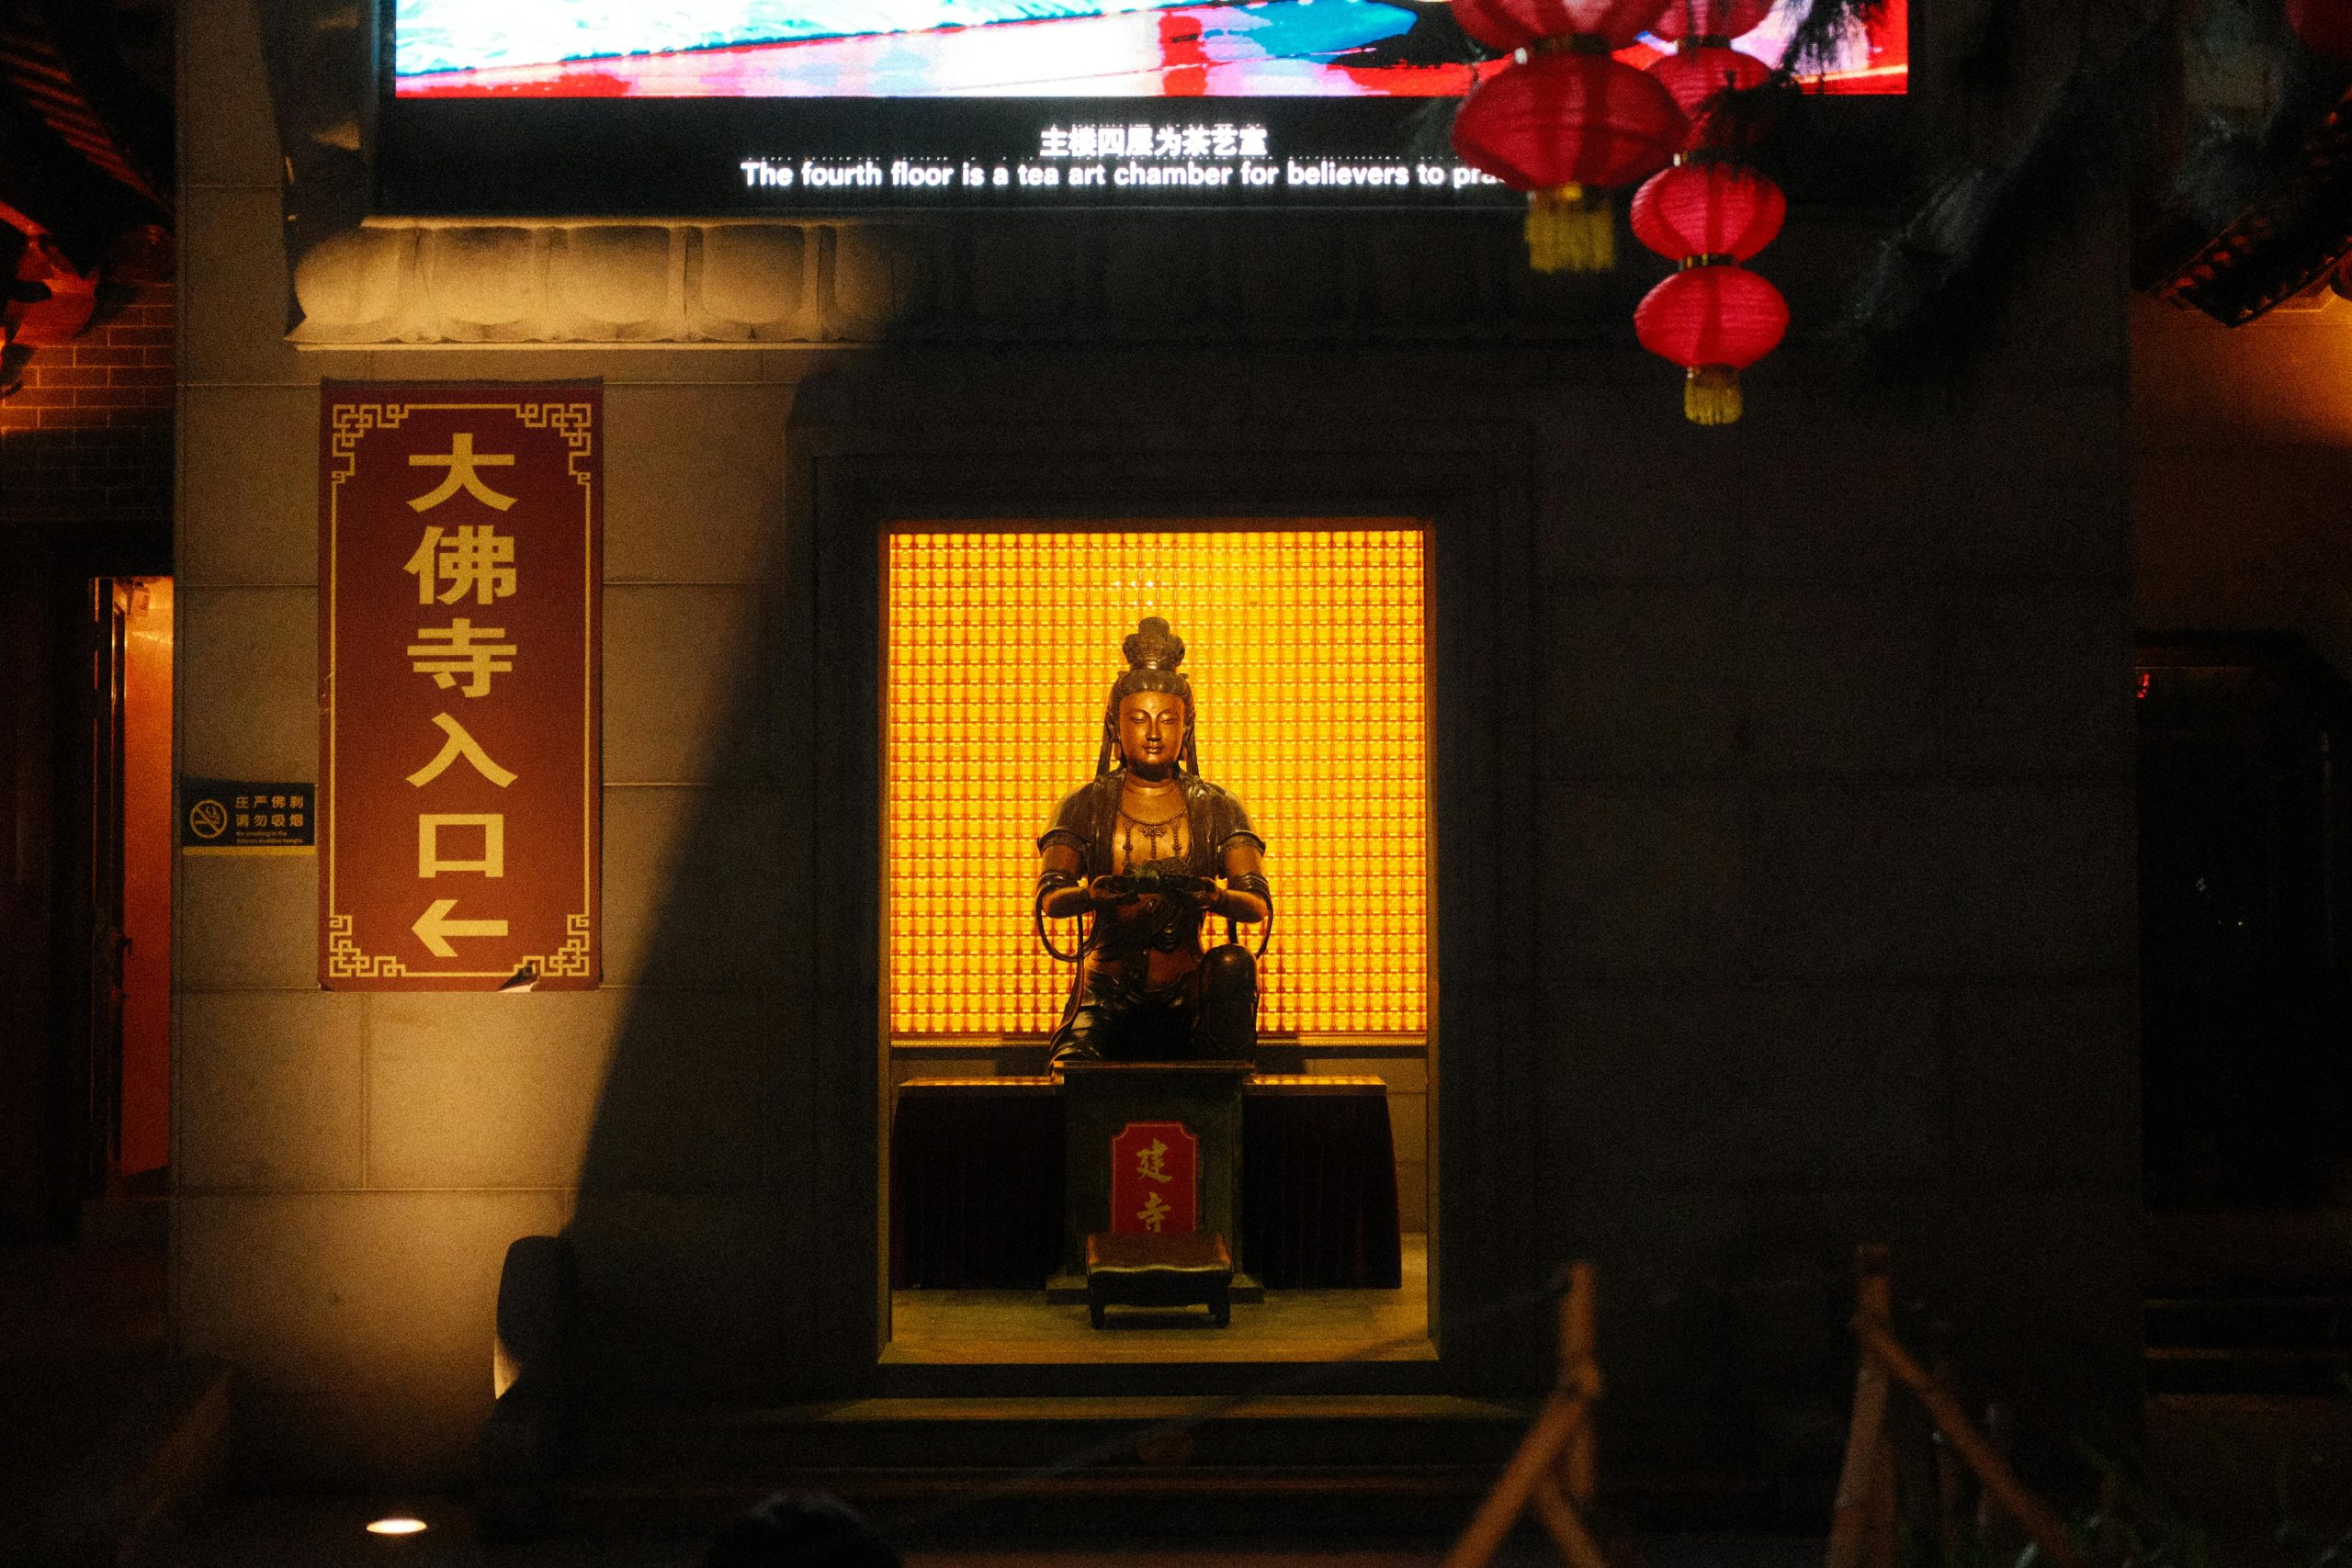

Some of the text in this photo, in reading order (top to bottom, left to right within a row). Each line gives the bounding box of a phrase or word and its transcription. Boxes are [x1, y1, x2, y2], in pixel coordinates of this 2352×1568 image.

[1039, 126, 1268, 157] 主楼四层为茶艺室
[741, 162, 794, 186] The
[801, 161, 882, 186] fourth
[890, 161, 955, 186] floor
[962, 162, 985, 186] is
[992, 166, 1009, 186] a
[1017, 164, 1059, 186] tea
[1069, 164, 1106, 186] art
[1114, 161, 1233, 186] chamber
[1239, 160, 1280, 186] for
[1287, 160, 1410, 186] believers
[1417, 164, 1445, 186] to
[404, 433, 518, 877] 大佛寺入口
[235, 814, 304, 828] 请勿吸烟
